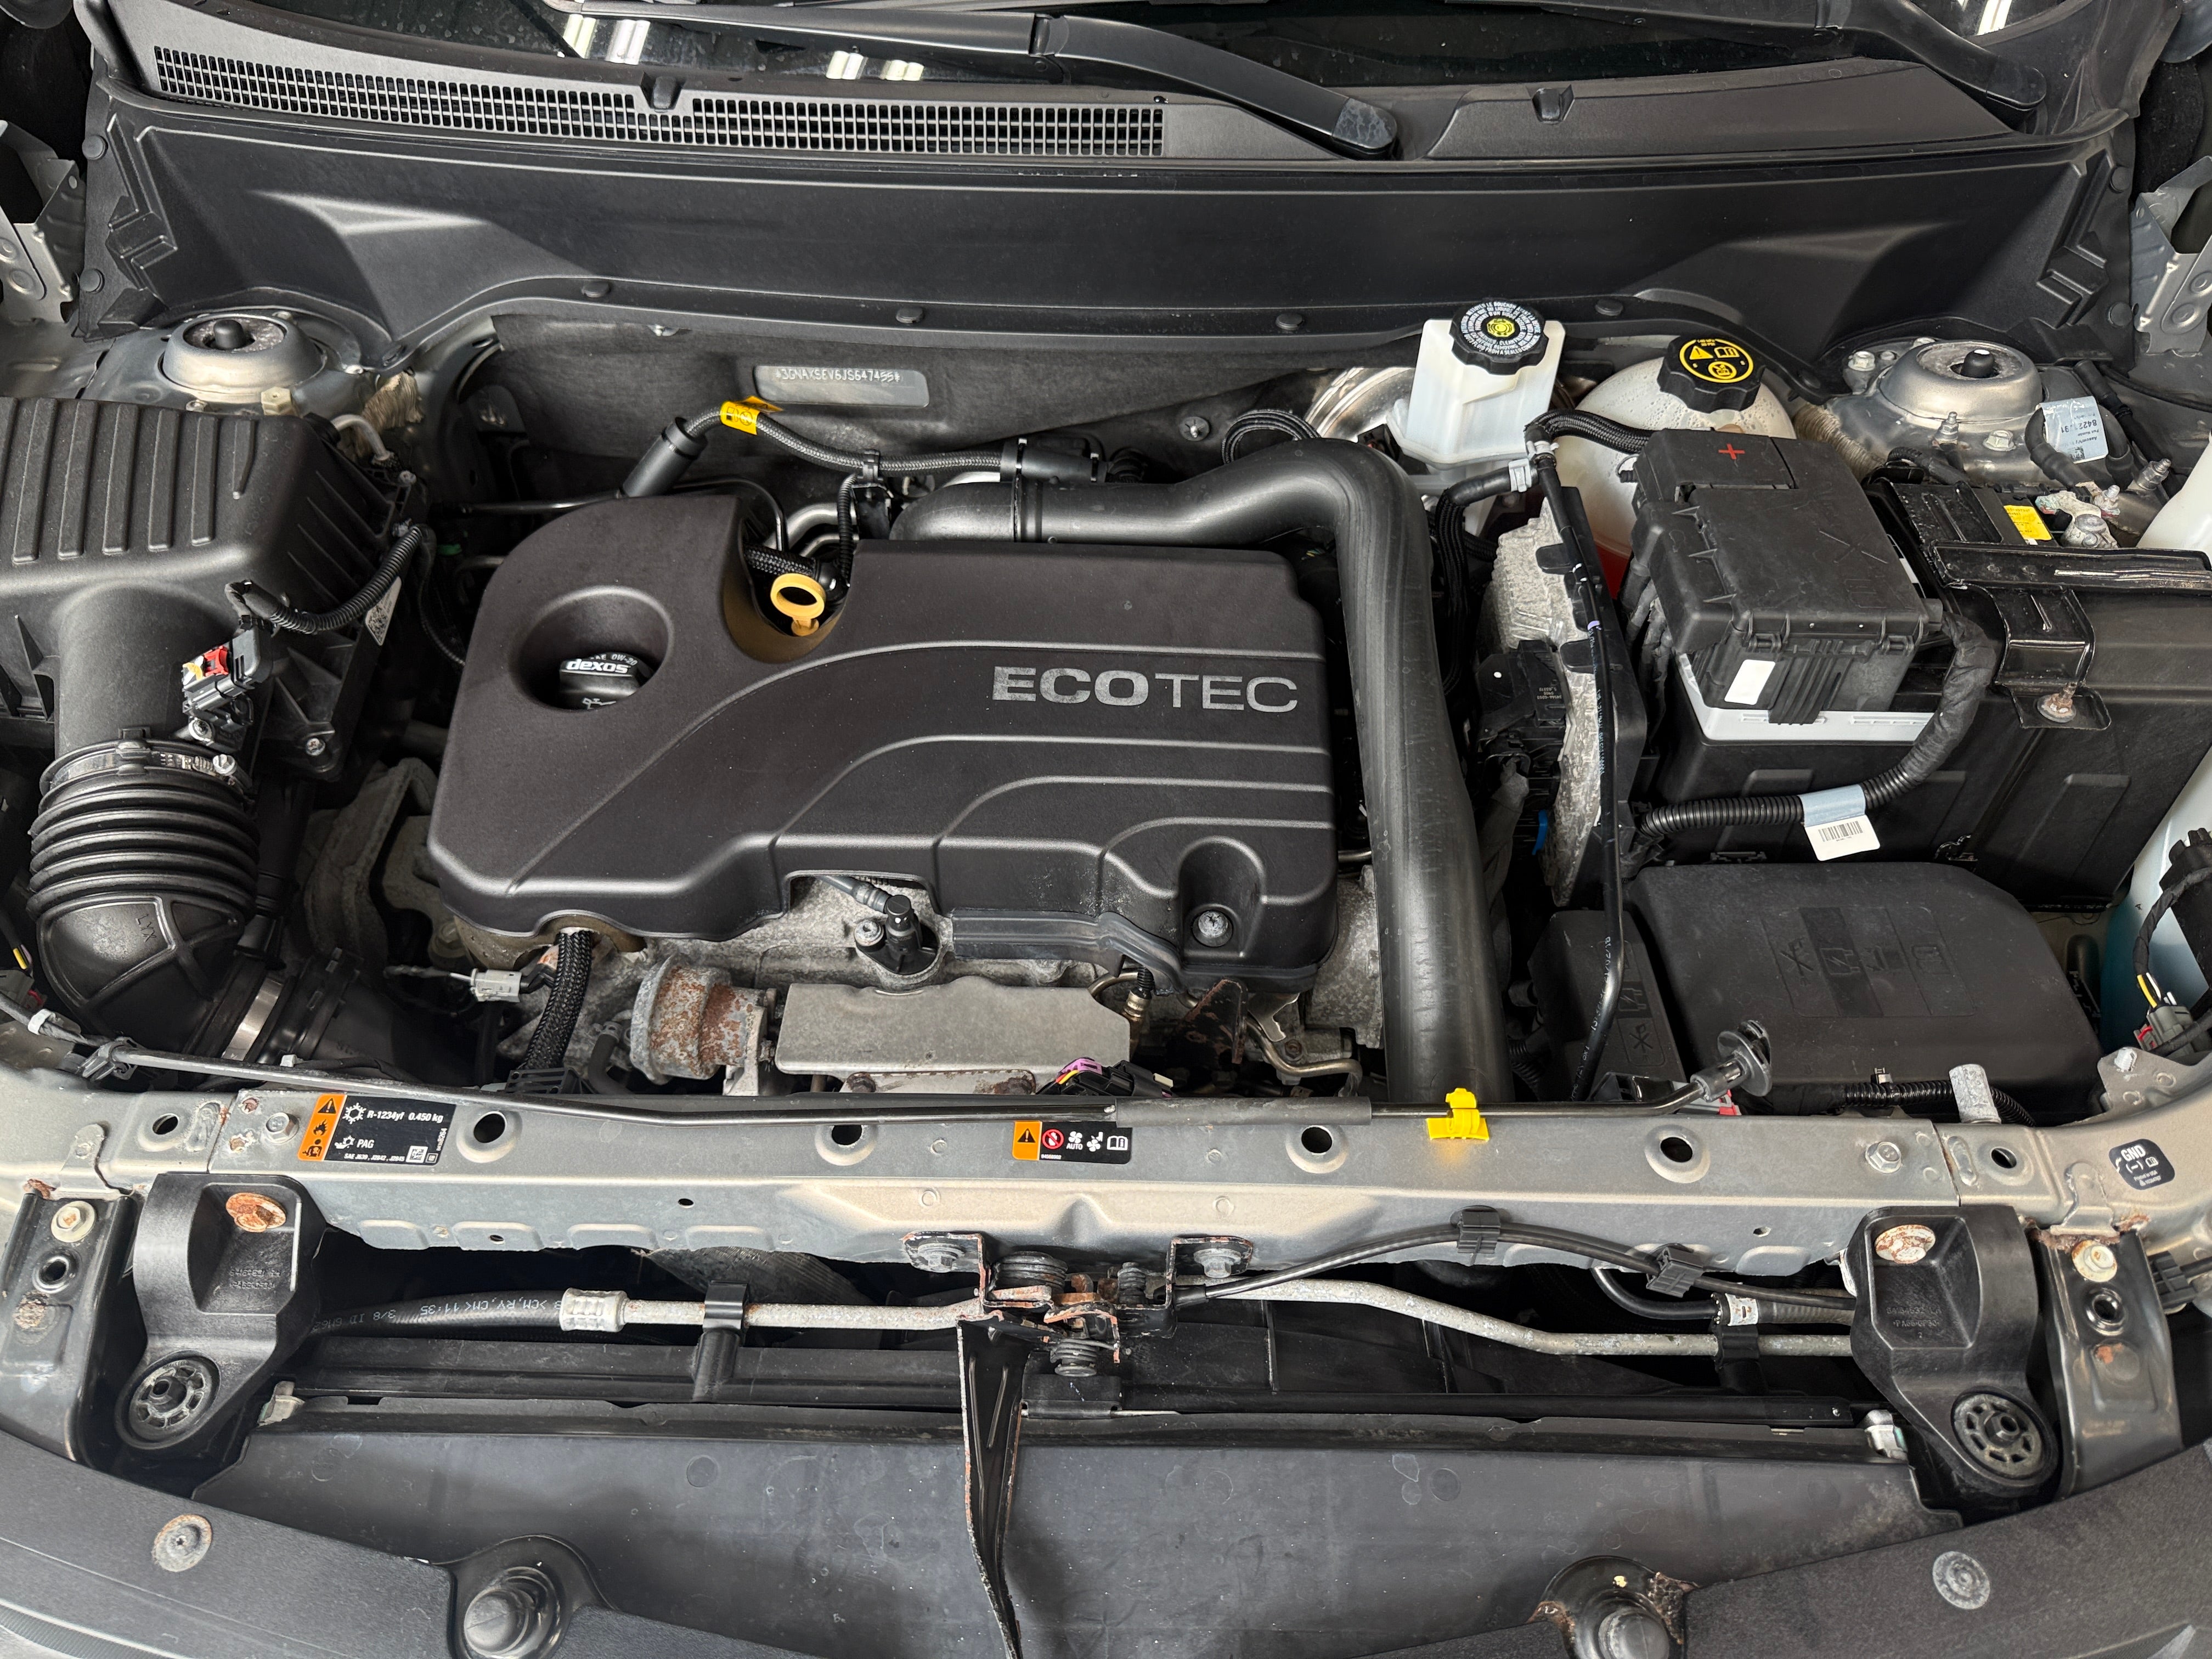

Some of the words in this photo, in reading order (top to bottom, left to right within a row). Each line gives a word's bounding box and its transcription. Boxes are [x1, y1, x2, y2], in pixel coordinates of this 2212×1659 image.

[566, 658, 630, 674] dexos
[611, 653, 638, 666] 0W-20
[992, 666, 1298, 713] ECOTEC
[366, 1111, 405, 1121] R-1234yf
[408, 1112, 431, 1121] 0.450
[432, 1113, 443, 1123] kg
[357, 1139, 375, 1149] PAG
[2120, 1145, 2146, 1161] GND
[373, 1309, 397, 1321] 3/8
[420, 1303, 460, 1316] 11:35
